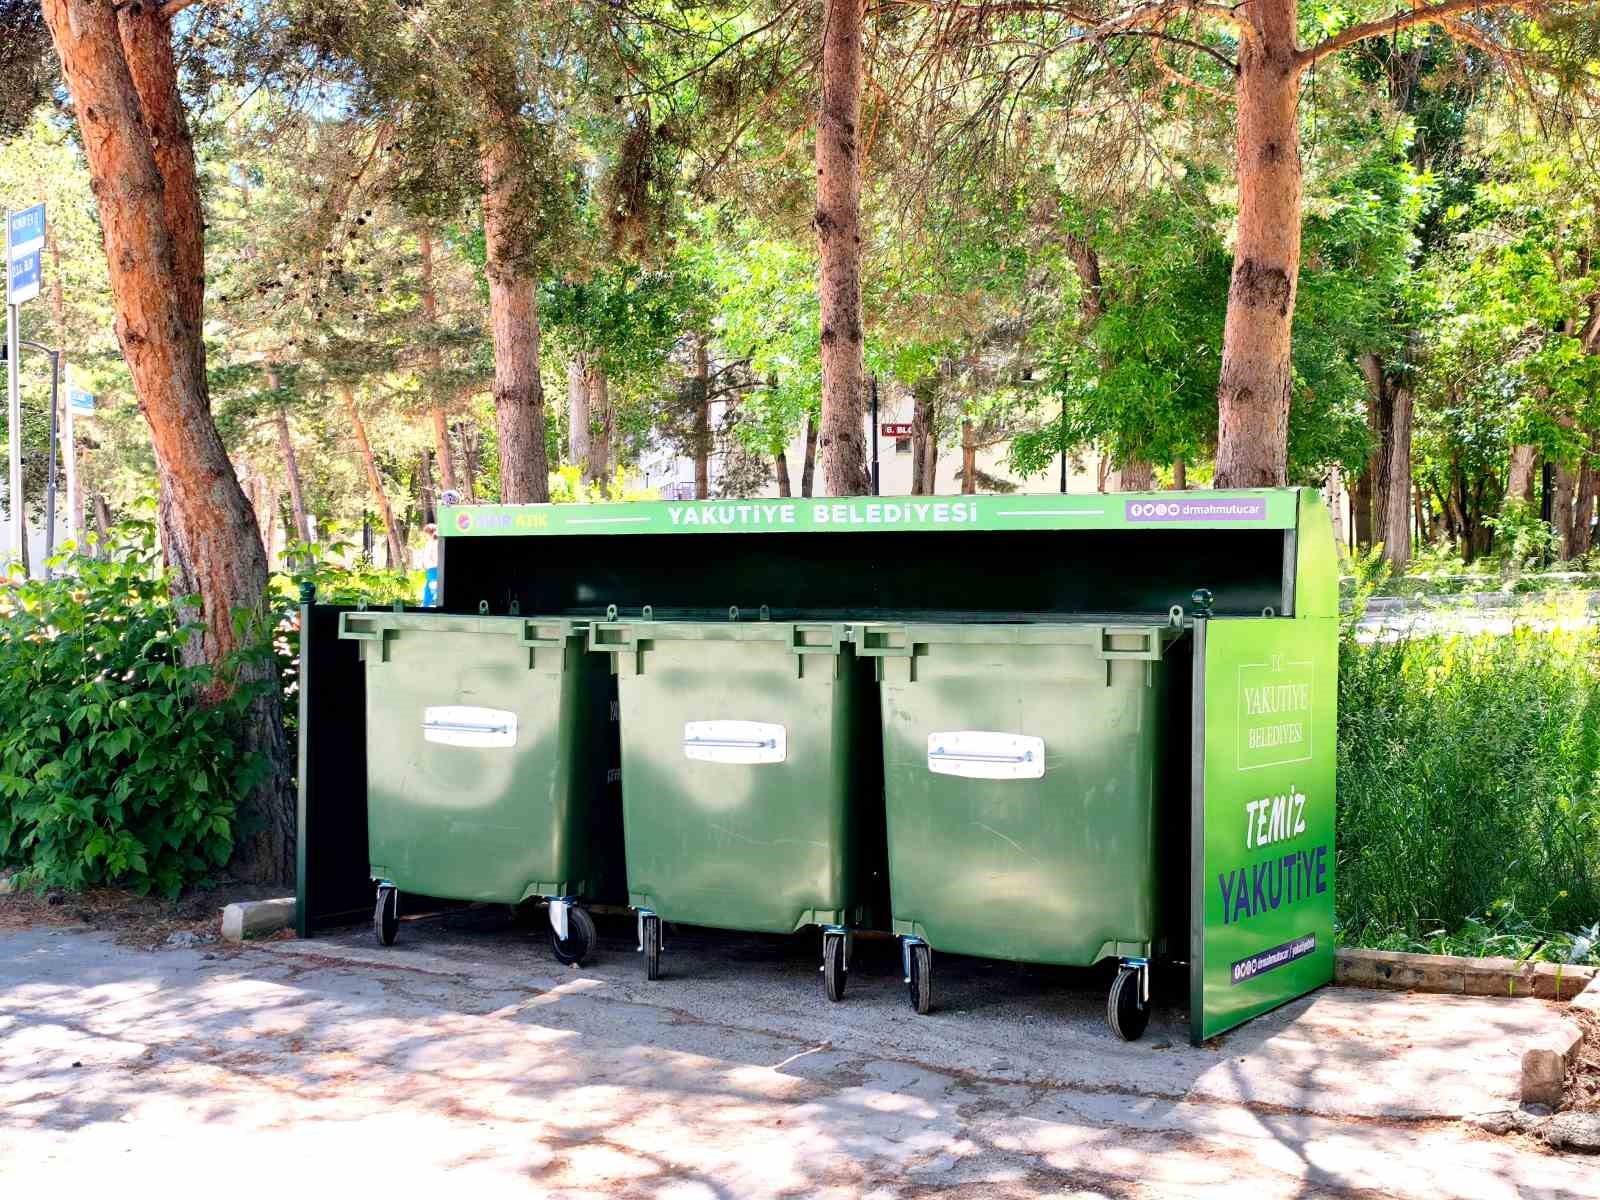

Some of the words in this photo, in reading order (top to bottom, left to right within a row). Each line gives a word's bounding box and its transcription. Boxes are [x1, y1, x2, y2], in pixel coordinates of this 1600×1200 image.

[667, 504, 795, 525] YAKUTİYE
[812, 502, 977, 524] BELEDİYESİ
[1183, 503, 1260, 515] drmahmutucar
[1246, 784, 1306, 849] TEMİZ
[1218, 846, 1328, 925] YAKUTİYE
